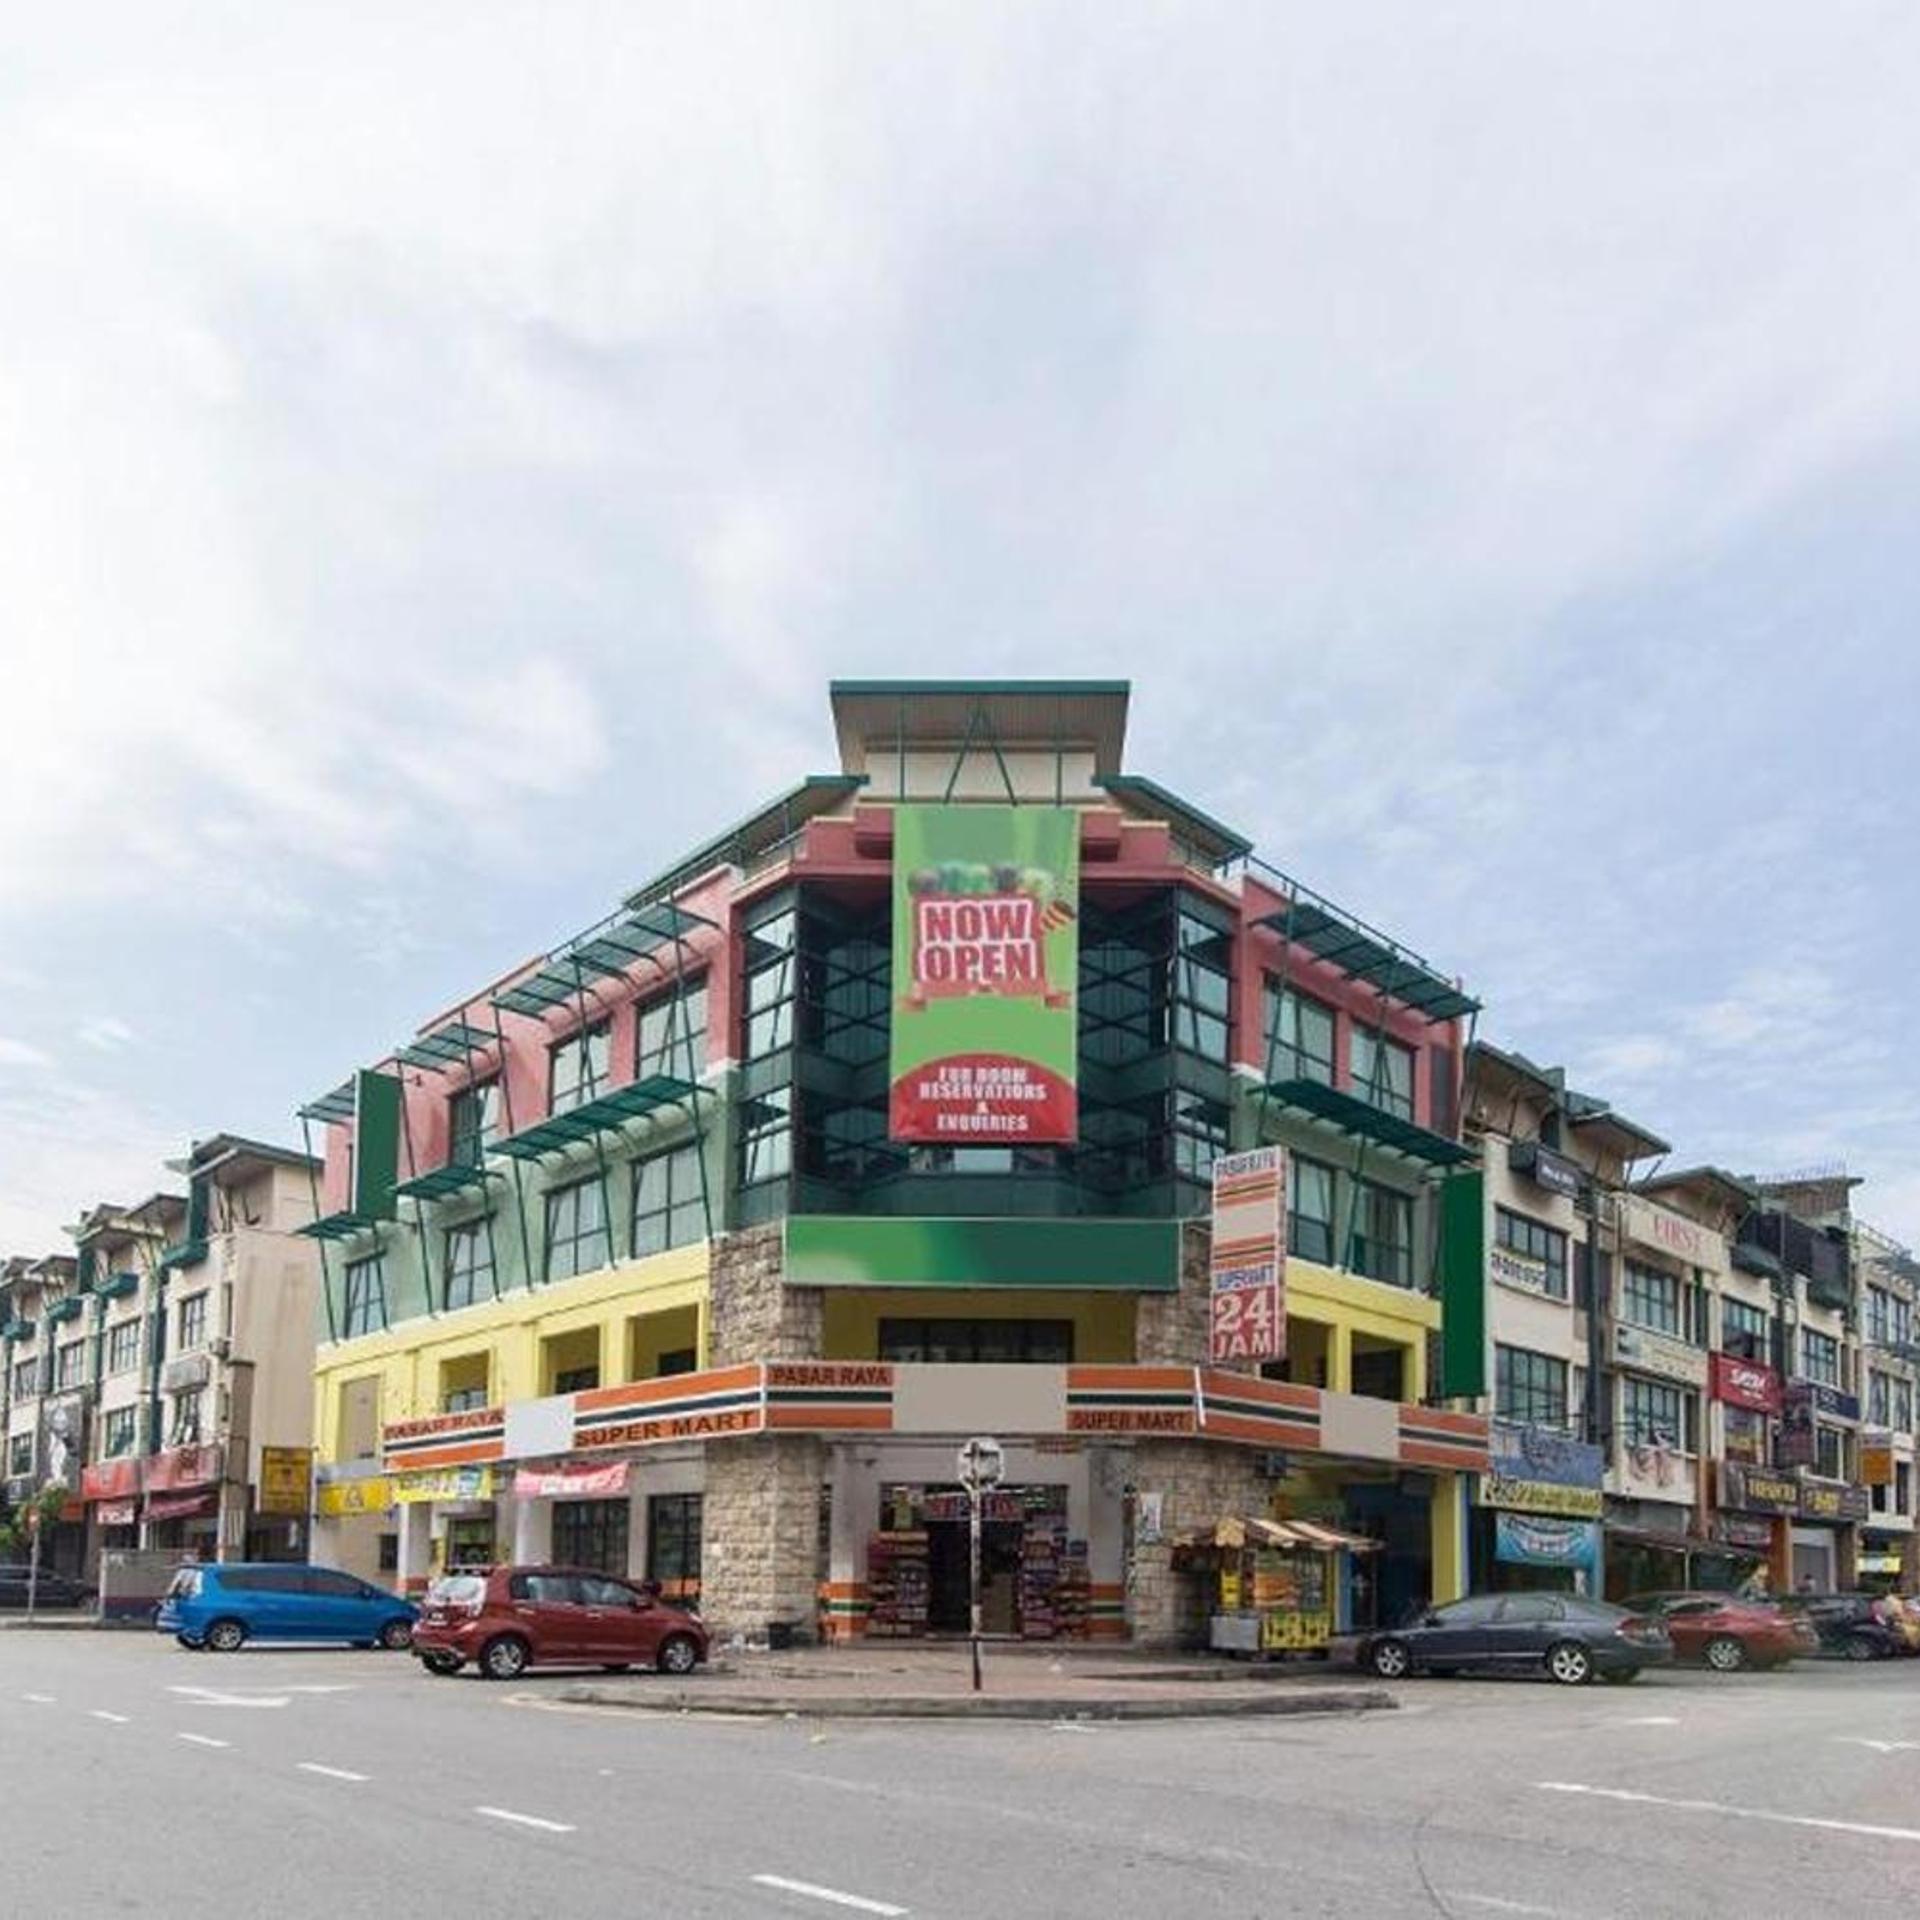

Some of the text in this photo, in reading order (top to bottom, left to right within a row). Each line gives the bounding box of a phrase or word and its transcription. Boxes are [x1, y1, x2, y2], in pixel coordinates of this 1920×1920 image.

[921, 901, 1032, 942] NOW
[922, 944, 1034, 983] OPEN
[939, 1066, 1026, 1083] FOR ROOM
[1214, 1288, 1272, 1333] 24
[1214, 1330, 1273, 1361] JAM
[772, 1366, 889, 1386] PASAR RAYA
[384, 1407, 504, 1440] PASAR RAYA
[574, 1409, 753, 1448] SUPER MART
[1073, 1411, 1186, 1431] SUPER MART
